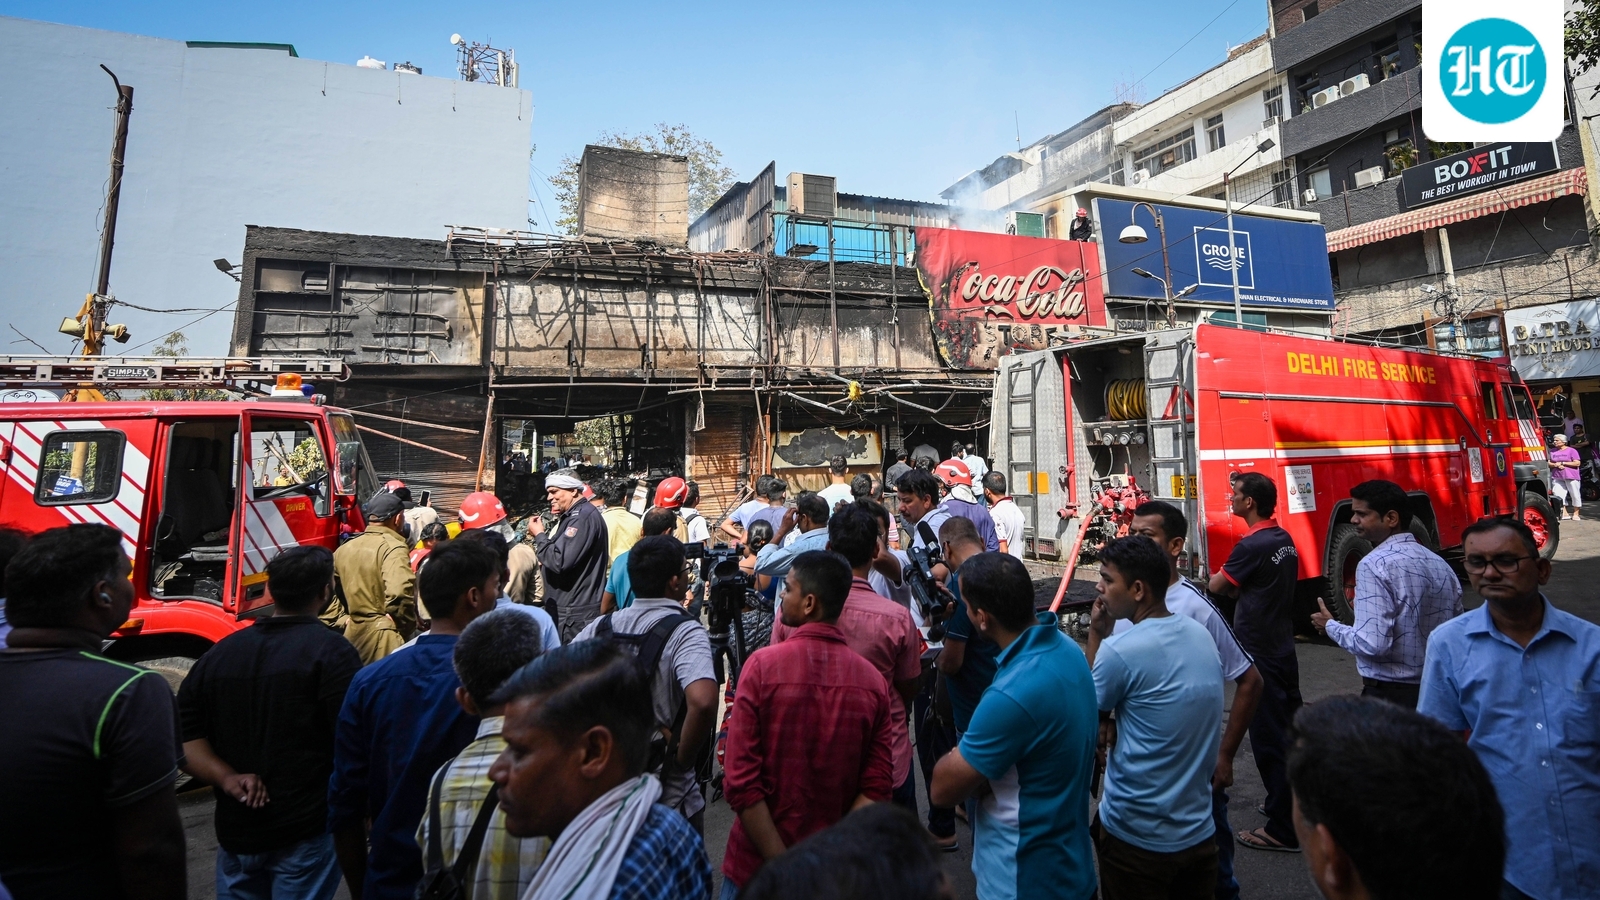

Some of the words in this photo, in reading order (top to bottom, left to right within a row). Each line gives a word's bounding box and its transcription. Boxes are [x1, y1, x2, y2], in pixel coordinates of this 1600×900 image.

[1434, 145, 1513, 184] BOXFIT
[1421, 188, 1435, 200] THE
[1436, 182, 1456, 196] BEST
[1457, 171, 1498, 190] WORKOUT
[1498, 168, 1508, 180] IN
[1510, 160, 1537, 177] TOWN
[1254, 294, 1282, 303] ELECTRICAL
[1288, 297, 1314, 305] HARDWARE
[1513, 318, 1591, 341] BATRA
[1510, 341, 1548, 357] TENT
[107, 368, 150, 377] SIMPLEX
[1286, 351, 1339, 377] DELHI
[1342, 357, 1378, 380] FIRE
[1380, 362, 1437, 385] SERVICE
[1271, 545, 1289, 565] SAFETY
